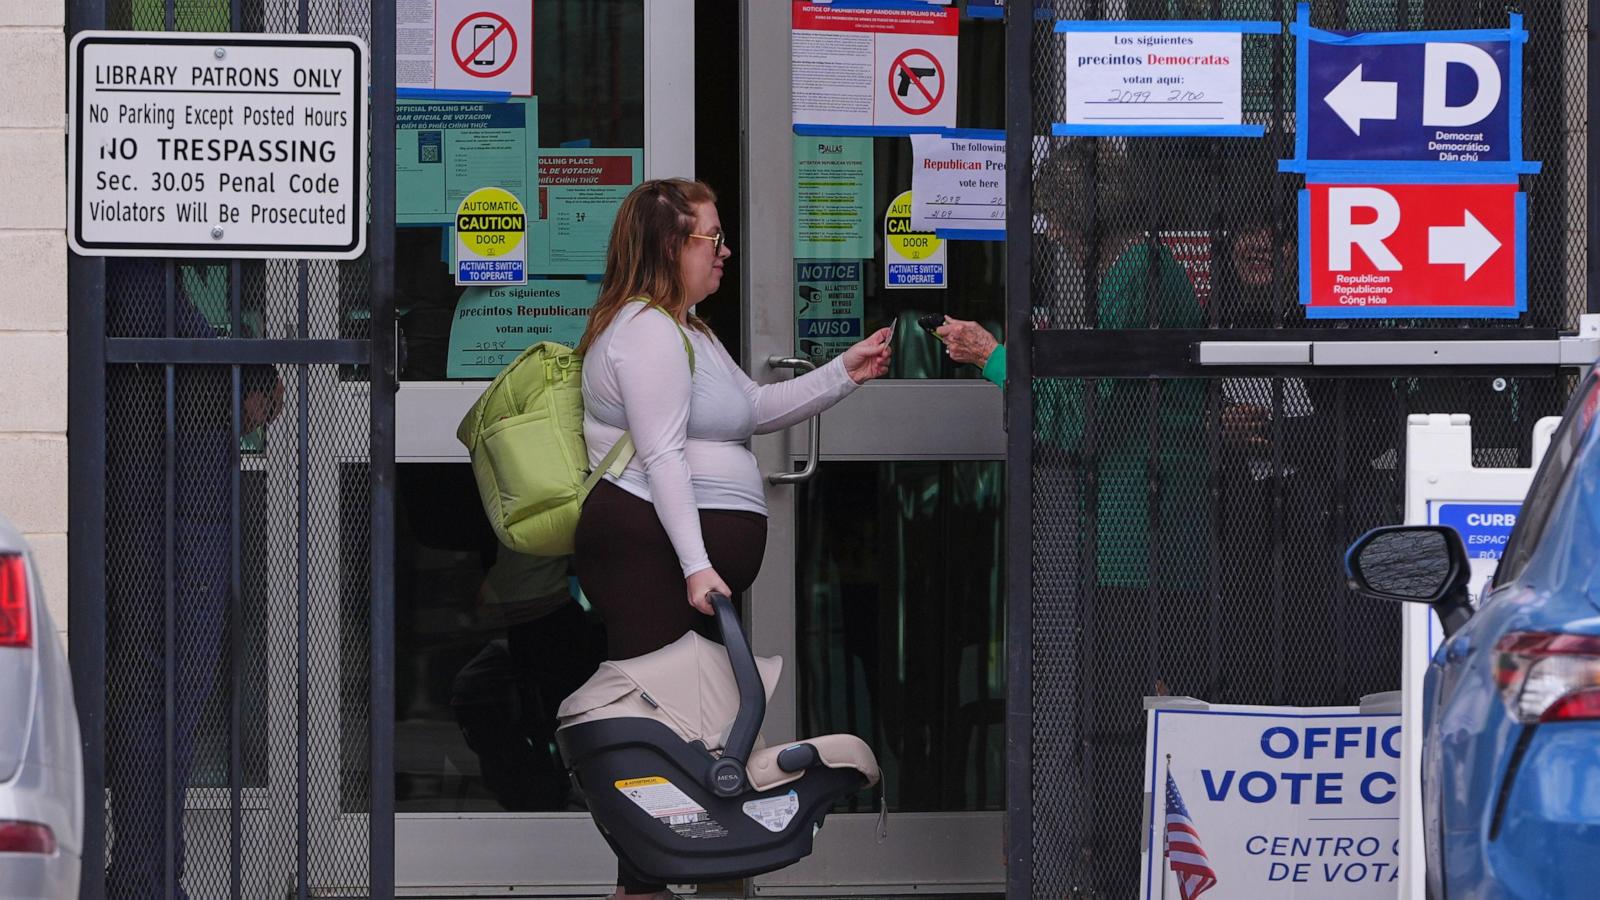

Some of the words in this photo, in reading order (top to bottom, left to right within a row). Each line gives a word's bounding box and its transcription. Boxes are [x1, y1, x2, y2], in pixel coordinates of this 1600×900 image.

[1114, 35, 1133, 45] Los
[1137, 35, 1193, 47] siguientes
[1078, 54, 1142, 67] precintos
[1147, 53, 1230, 65] Democratas
[96, 65, 178, 86] LIBRARY
[192, 67, 279, 87] PATRONS
[293, 68, 342, 88] ONLY
[1123, 76, 1153, 85] votan
[1422, 42, 1501, 127] D
[1107, 89, 1151, 103] 2099
[1167, 89, 1205, 101] 2100
[89, 104, 108, 123] No
[119, 104, 175, 129] Parking
[185, 105, 233, 130] Except
[244, 106, 294, 126] Posted
[305, 107, 347, 127] Hours
[1435, 131, 1483, 141] Democrat
[100, 138, 138, 160] NO
[157, 138, 336, 162] TRESPASSING
[950, 142, 967, 151] The
[1428, 141, 1490, 152] Democrático
[1439, 152, 1459, 161] Dân
[924, 159, 982, 171] Republican
[96, 171, 138, 191] Sec.
[151, 172, 205, 192] 30.05
[219, 172, 275, 193] Penal
[289, 173, 339, 193] Code
[959, 179, 977, 187] vote
[980, 179, 999, 188] here
[90, 200, 165, 222] Violators
[177, 202, 208, 223] Will
[220, 204, 240, 223] Be
[251, 204, 346, 224] Prosecuted
[463, 202, 518, 211] AUTOMATIC
[460, 217, 522, 230] CAUTION
[1328, 187, 1403, 271] R
[476, 235, 505, 244] DOOR
[903, 238, 928, 247] DOOR
[461, 262, 494, 271] ACTIVATE
[495, 262, 522, 271] SWITCH
[889, 265, 918, 274] ACTIVATE
[919, 265, 942, 274] SWITCH
[469, 271, 480, 280] TO
[481, 271, 513, 280] OPERATE
[802, 266, 855, 279] NOTICE
[898, 275, 907, 283] TO
[907, 275, 935, 283] OPERATE
[1336, 275, 1390, 285] Republican
[489, 289, 506, 297] Los
[509, 289, 561, 299] siguientes
[1333, 285, 1393, 295] Republicano
[1368, 295, 1387, 305] Hòa
[459, 306, 513, 319] precintos
[496, 325, 524, 334] votan
[808, 321, 850, 335] AVISO
[1467, 513, 1516, 526] CURB
[717, 774, 738, 782] MESA
[1200, 769, 1344, 804] VOTE
[1360, 771, 1397, 804] C
[1246, 835, 1379, 857] CENTRO
[1268, 862, 1311, 882] DE
